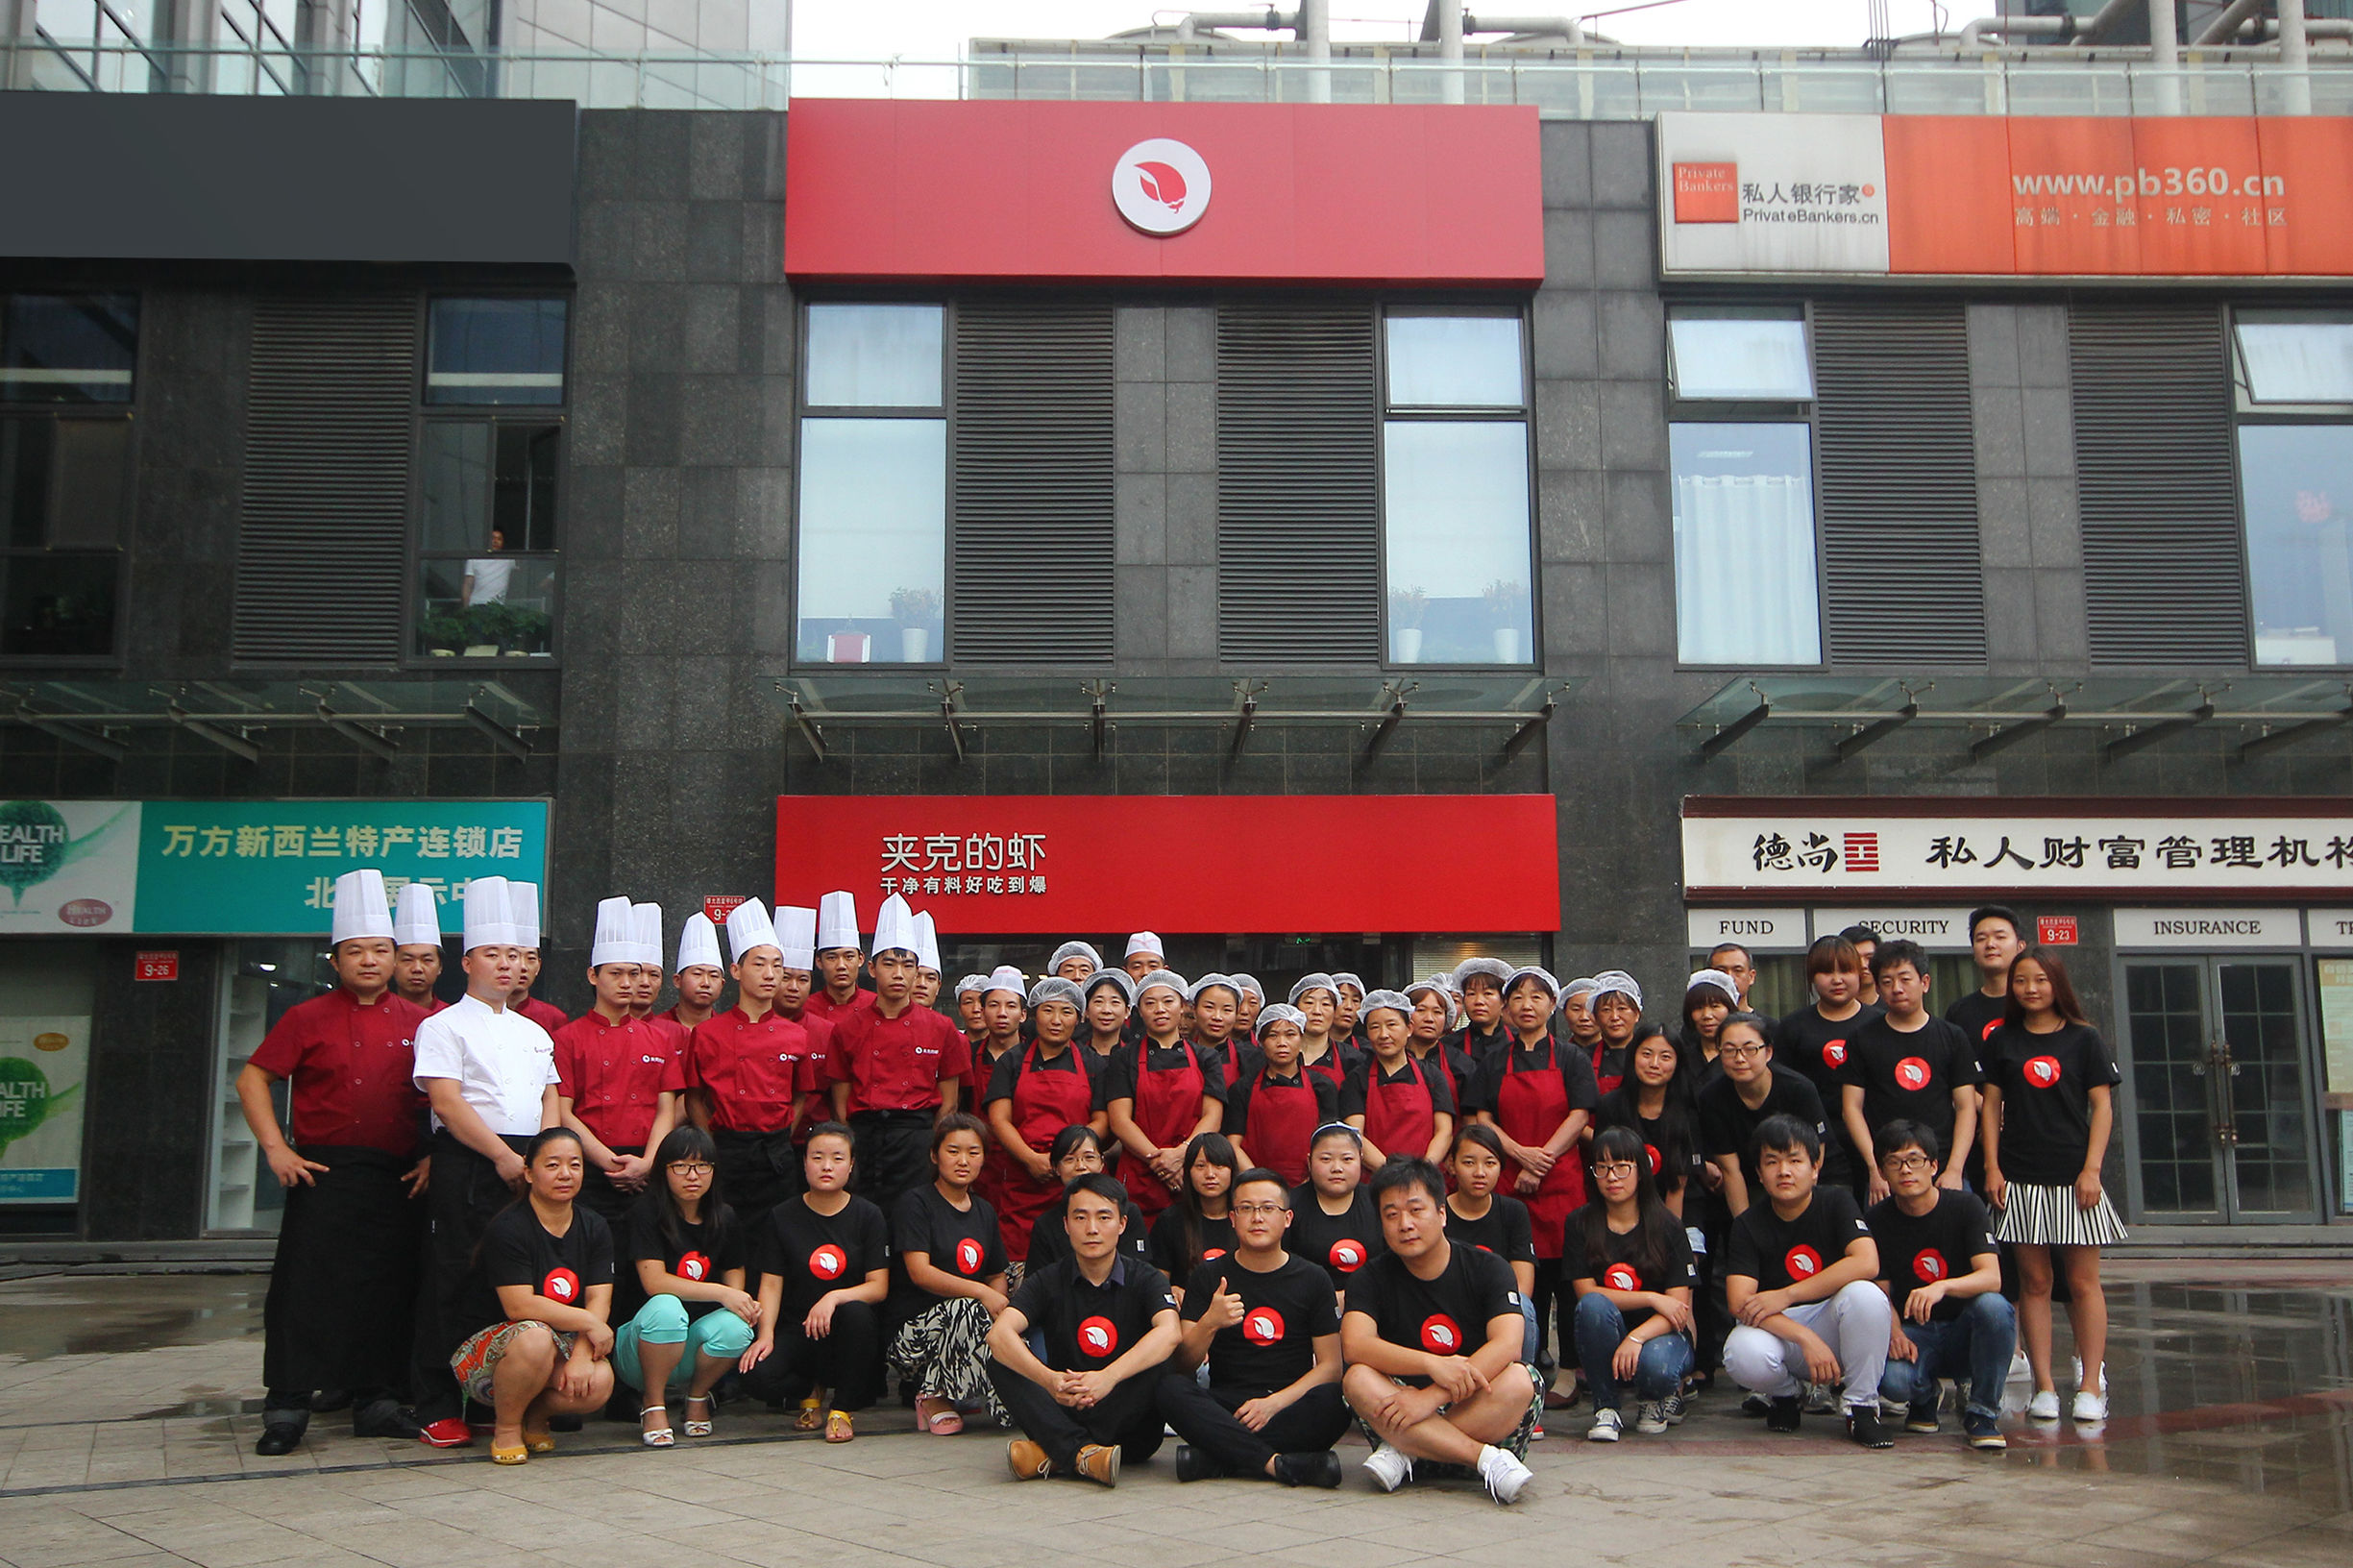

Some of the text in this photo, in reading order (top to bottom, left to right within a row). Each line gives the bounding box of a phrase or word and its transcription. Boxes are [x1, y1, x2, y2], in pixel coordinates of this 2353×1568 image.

[1679, 166, 1727, 179] Private
[1679, 180, 1733, 192] Bankers
[1742, 183, 1860, 205] 私人银行家
[2012, 167, 2286, 204] www.pb360.cn
[161, 824, 523, 858] 万方新西兰特产连锁店
[1, 845, 43, 863] LIFE
[881, 832, 1046, 872] 夹克的虾
[1752, 832, 1839, 873] 德尚
[880, 875, 1047, 895] 干净有料好吃到爆
[1720, 920, 1774, 935] FUND
[2047, 928, 2071, 942] 9-23
[2153, 920, 2262, 935] INSURANCE
[144, 964, 170, 977] 9-26
